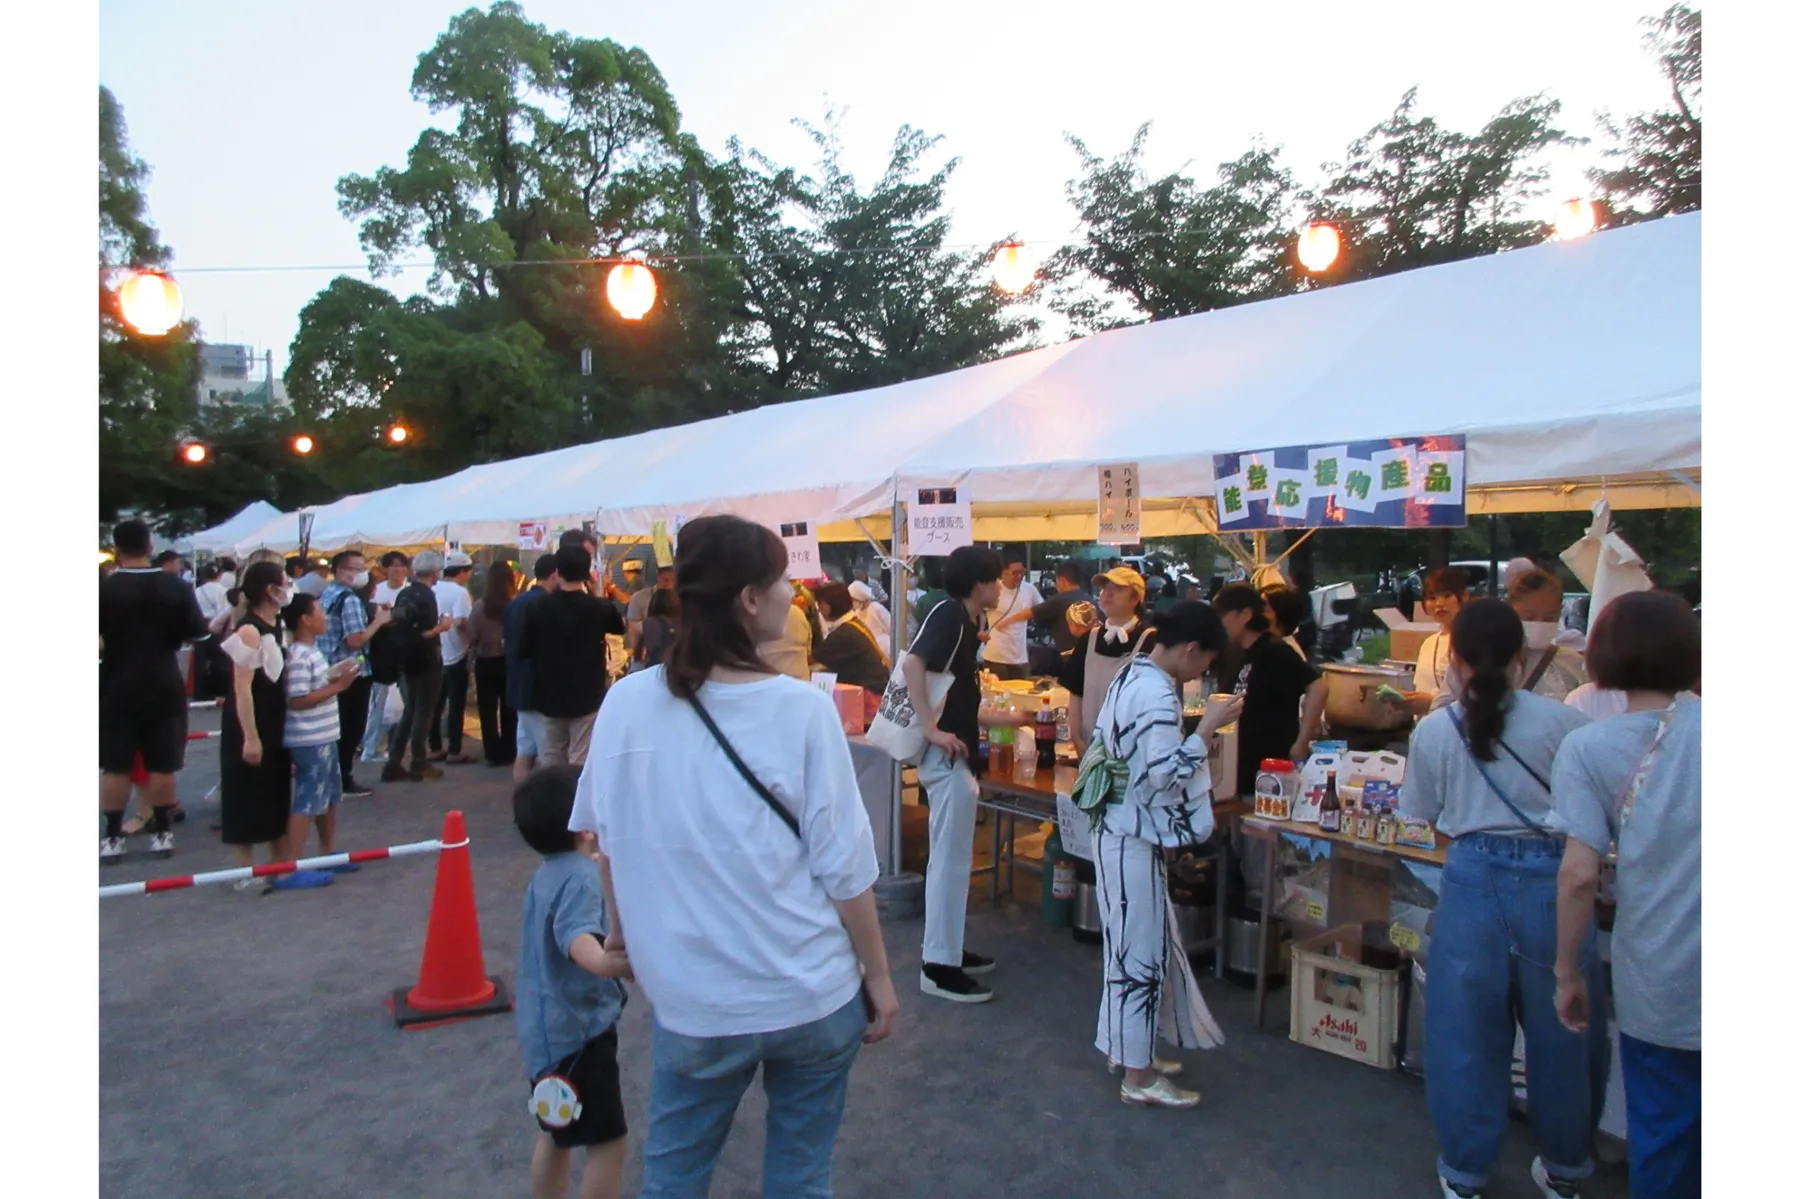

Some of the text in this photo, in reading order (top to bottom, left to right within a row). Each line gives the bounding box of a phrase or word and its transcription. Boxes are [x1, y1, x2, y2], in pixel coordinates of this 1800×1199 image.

[1223, 457, 1452, 514] 能登応援物産品
[913, 515, 964, 529] 能登支援販売
[927, 531, 951, 544] ブース
[1319, 1012, 1358, 1036] Asahi
[1355, 1038, 1367, 1053] 20
